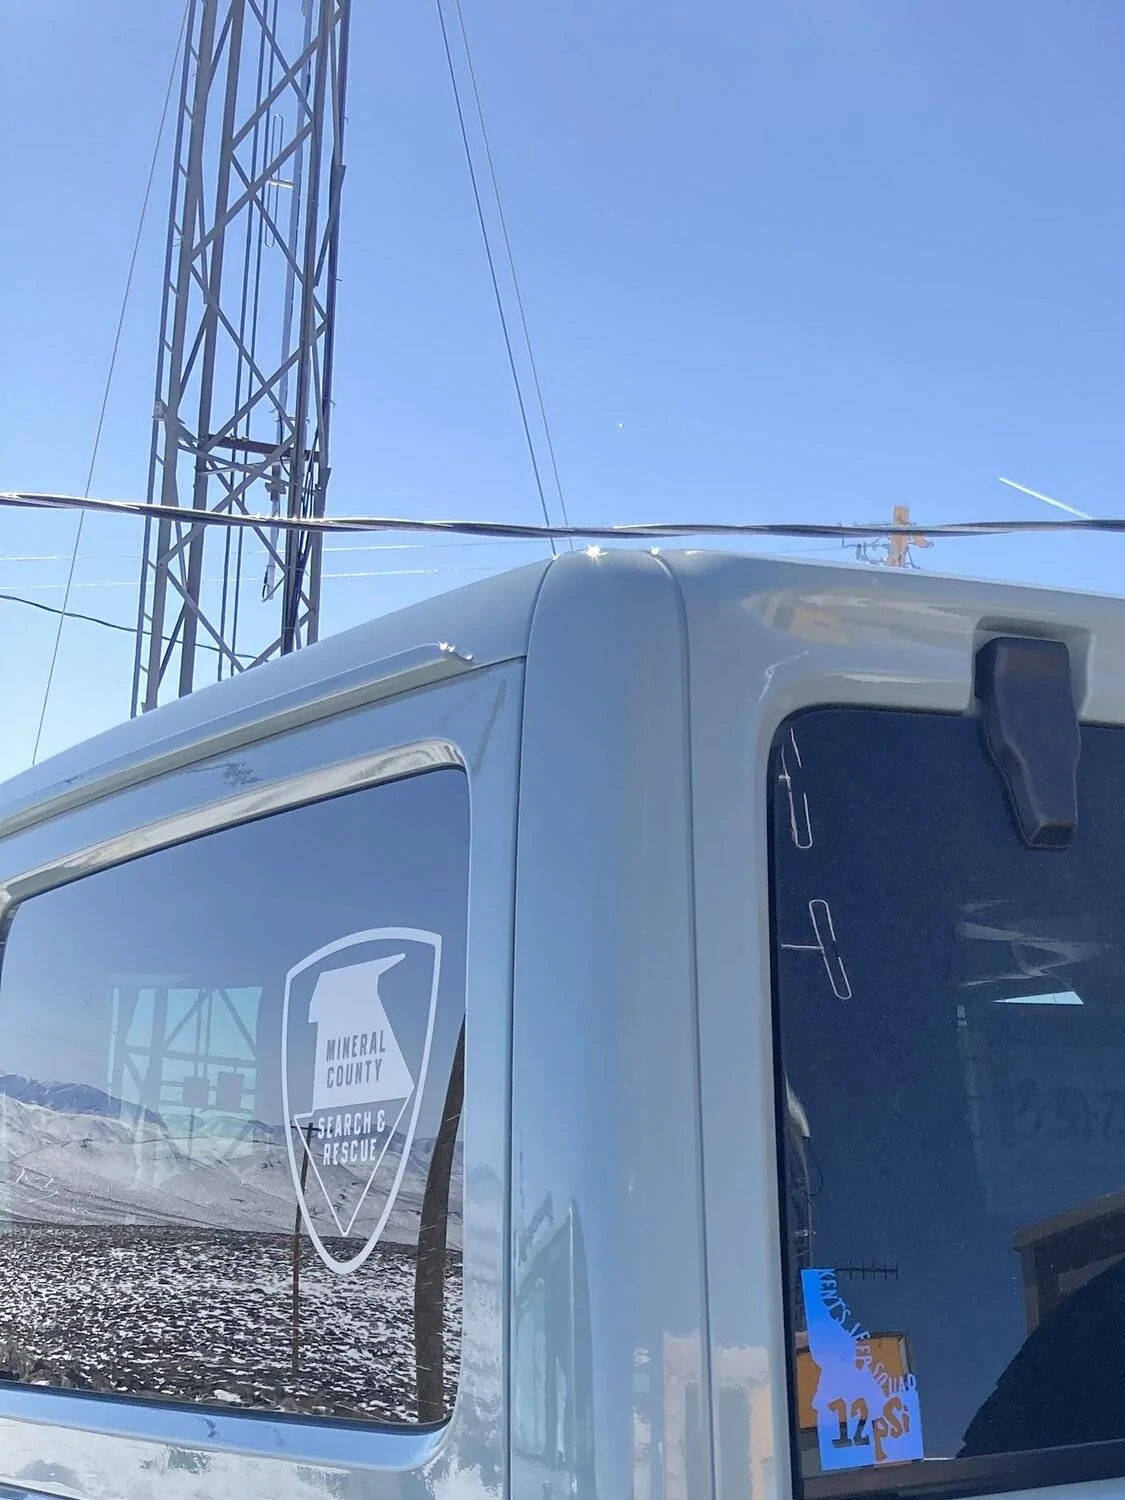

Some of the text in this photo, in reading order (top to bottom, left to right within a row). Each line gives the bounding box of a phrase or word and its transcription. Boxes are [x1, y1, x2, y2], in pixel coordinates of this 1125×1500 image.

[327, 1030, 385, 1061] MINERAL
[327, 1059, 382, 1088] COUNTY
[318, 1109, 385, 1140] SEARCH &
[323, 1139, 376, 1166] RESCUE
